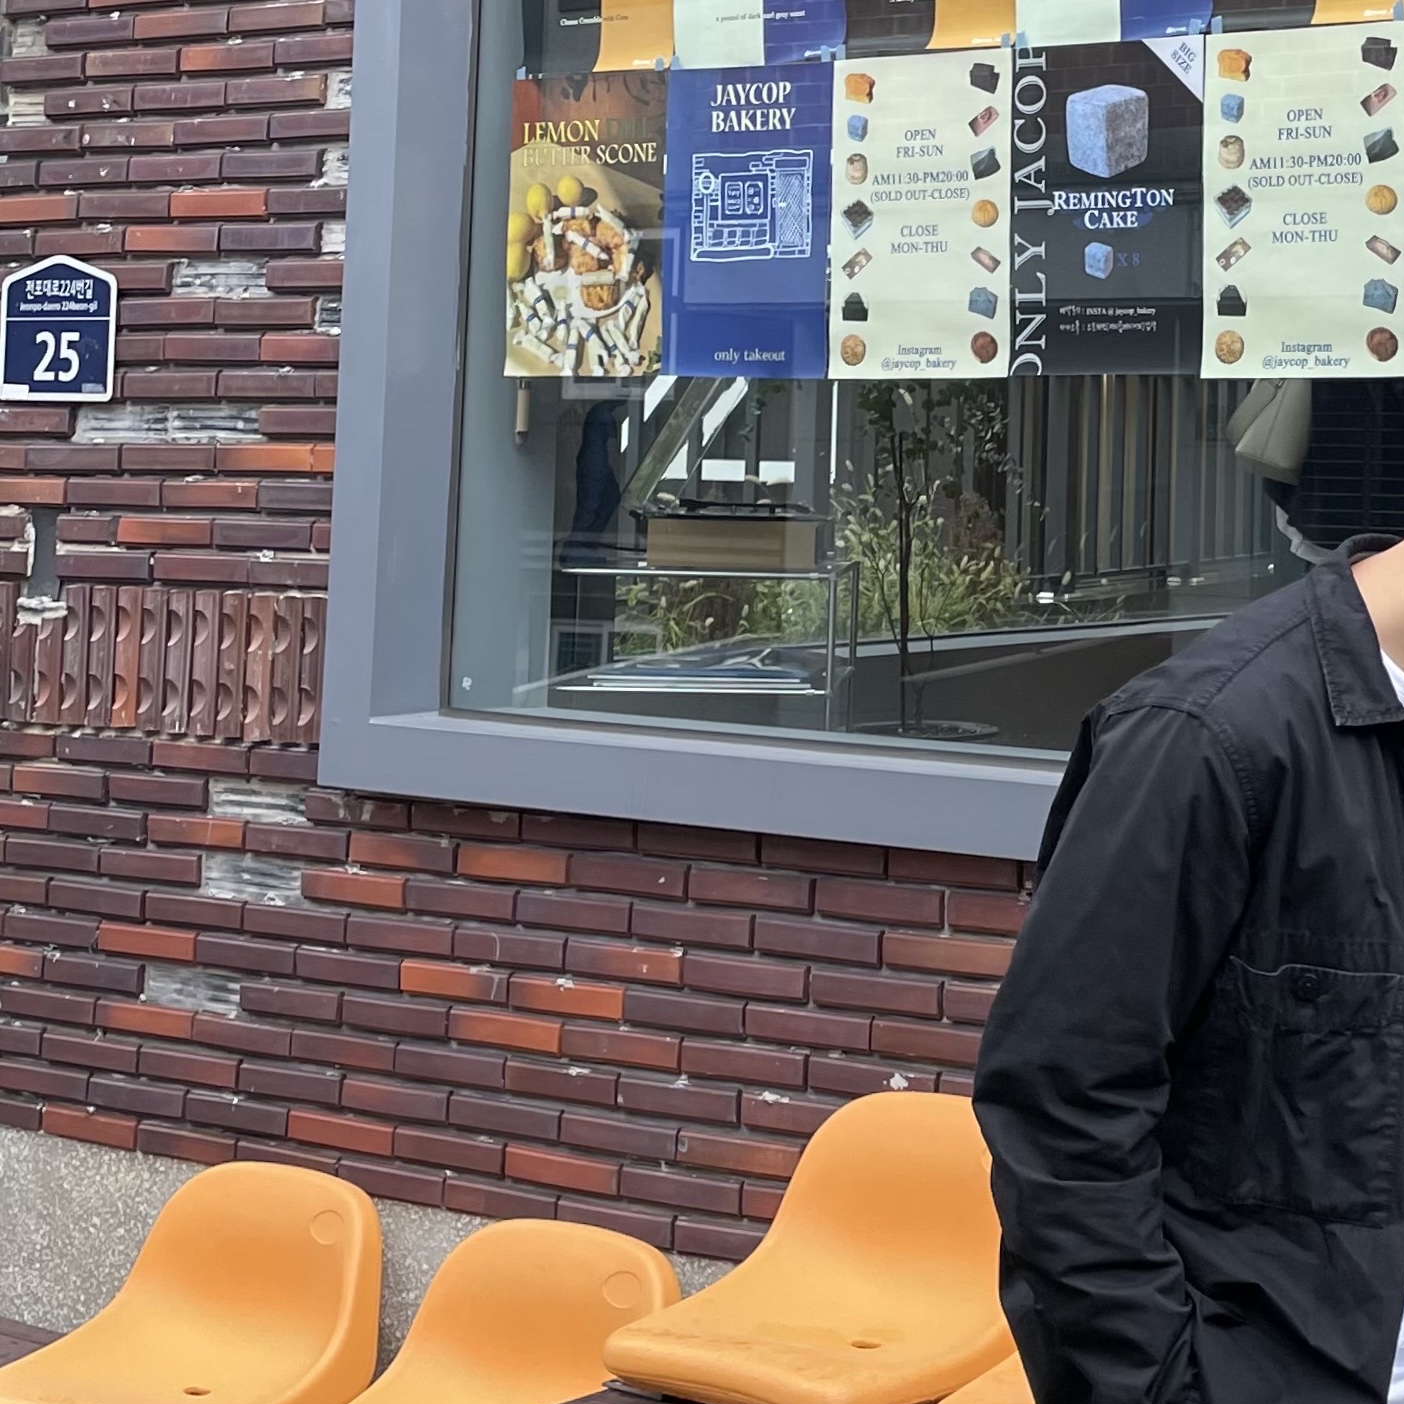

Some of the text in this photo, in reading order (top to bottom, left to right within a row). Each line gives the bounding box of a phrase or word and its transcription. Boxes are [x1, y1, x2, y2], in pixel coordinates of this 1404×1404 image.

[1179, 41, 1196, 62] BIG
[1171, 49, 1192, 74] SIZE
[710, 81, 792, 107] JAYCOP
[711, 107, 797, 132] BAKERY
[1286, 108, 1323, 122] OPEN
[523, 119, 600, 144] LEMON
[904, 129, 936, 141] OPEN
[1277, 125, 1332, 140] FRI-SUN
[523, 142, 657, 167] BUTTER SCONE
[896, 145, 944, 158] FRI-SUN
[1249, 152, 1362, 170] AM11:30-PM20:00
[1248, 172, 1363, 190] (SOLD OUT-CLOSE)
[870, 187, 970, 204] (SOLD OUT-CLOSE)
[1052, 187, 1175, 210] REMINGTON
[1084, 209, 1139, 229] CAKE
[1282, 212, 1328, 226] CLOSE
[900, 224, 939, 237] CLOSE
[1272, 229, 1339, 244] MON-THU
[890, 240, 948, 254] MON-THU
[33, 331, 81, 382] 25
[714, 347, 786, 365] only takeout
[897, 344, 942, 358] Instagram
[1281, 341, 1333, 355] Instagram
